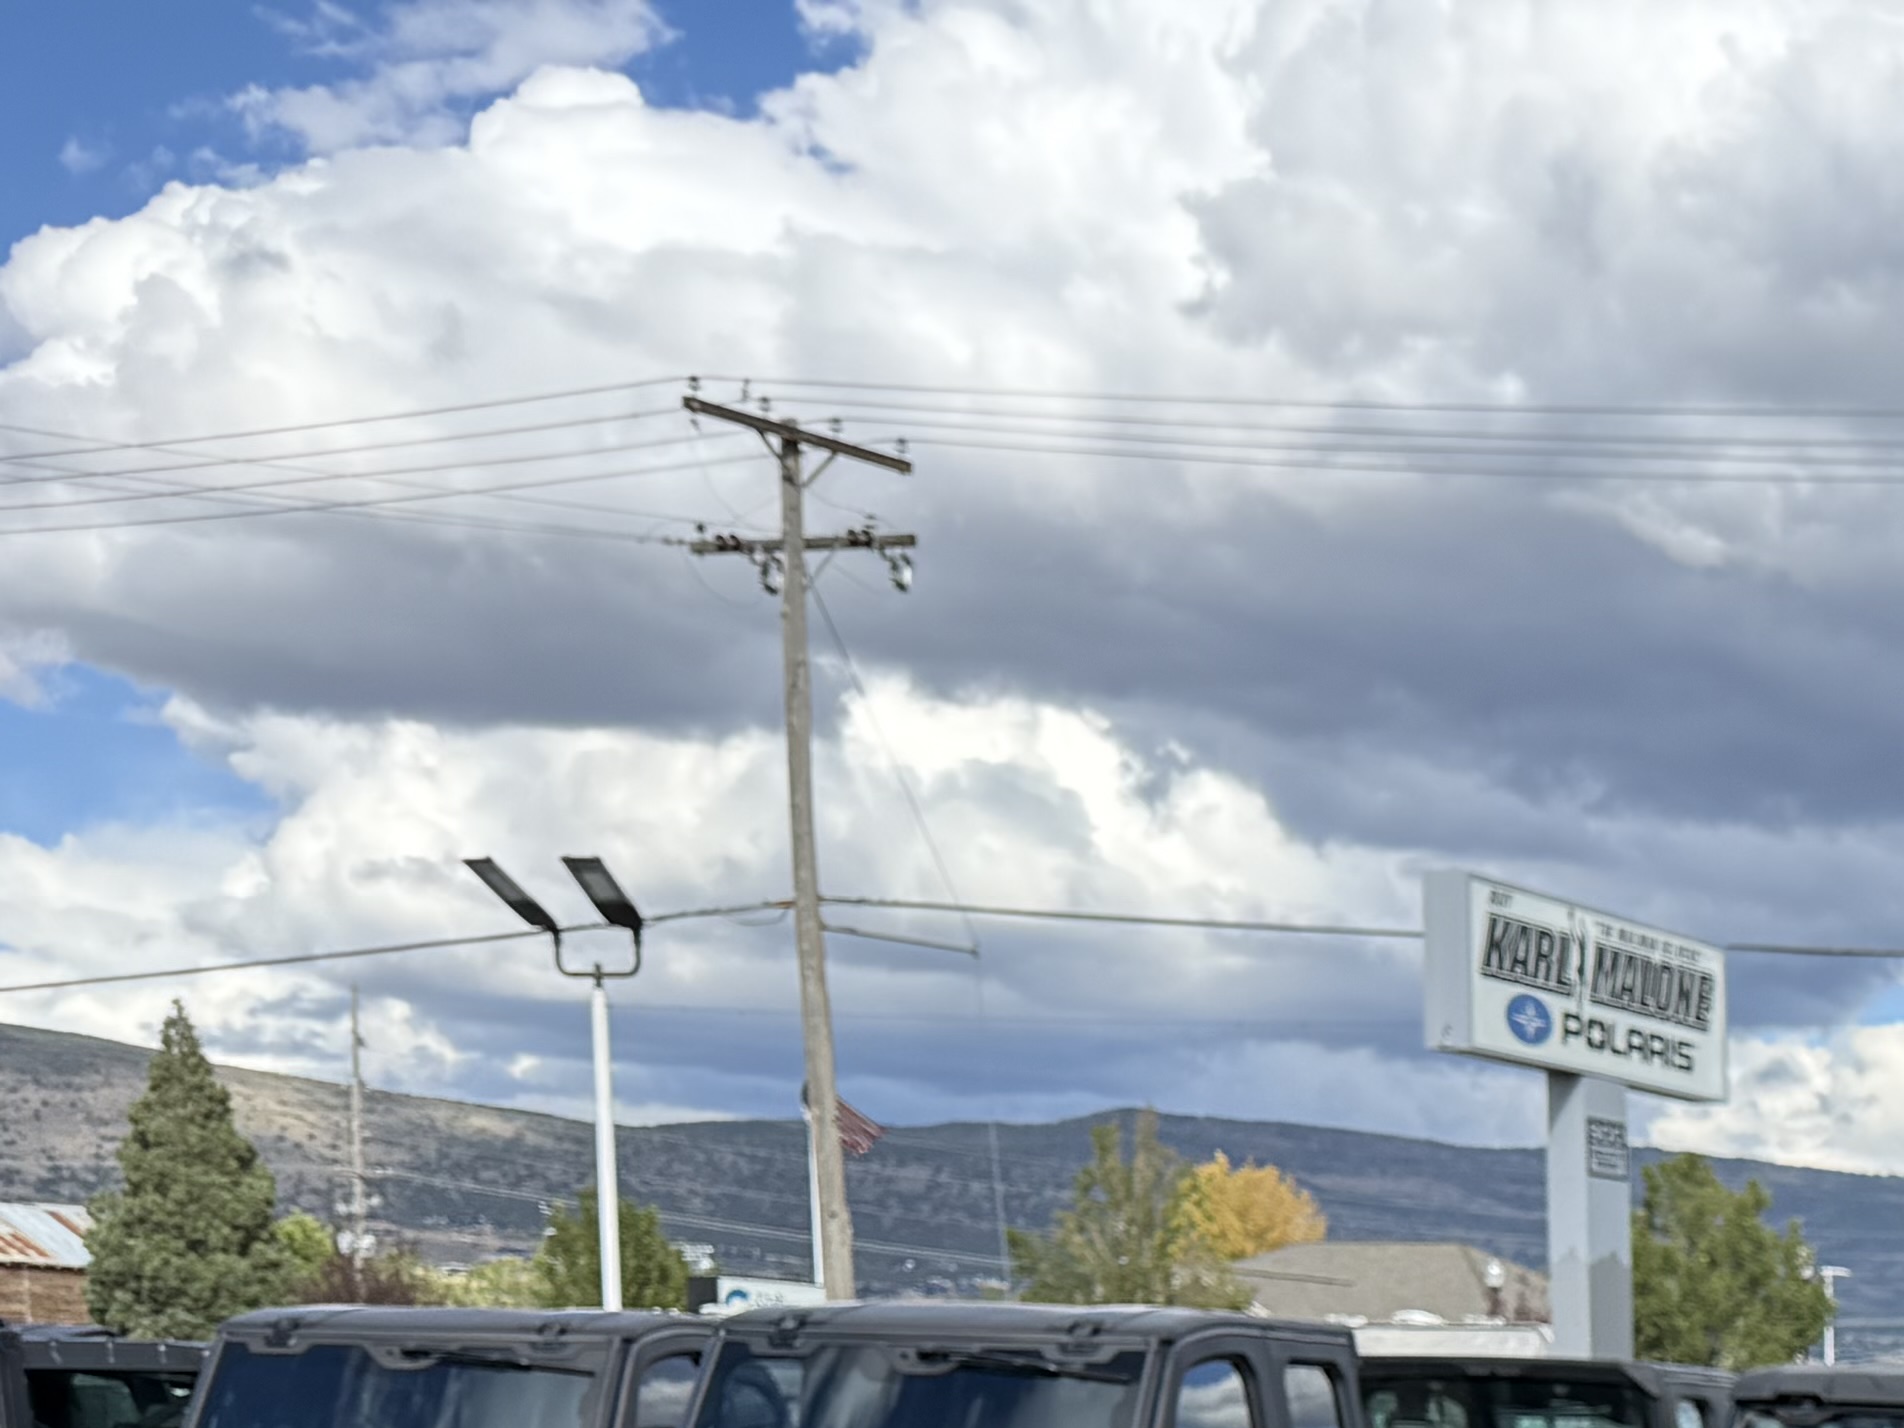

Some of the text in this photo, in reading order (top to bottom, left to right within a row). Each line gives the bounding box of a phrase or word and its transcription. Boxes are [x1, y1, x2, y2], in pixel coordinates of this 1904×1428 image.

[1484, 914, 1573, 989] KARL
[1591, 944, 1713, 1024] MALONE
[1560, 1011, 1696, 1073] POLARIS
